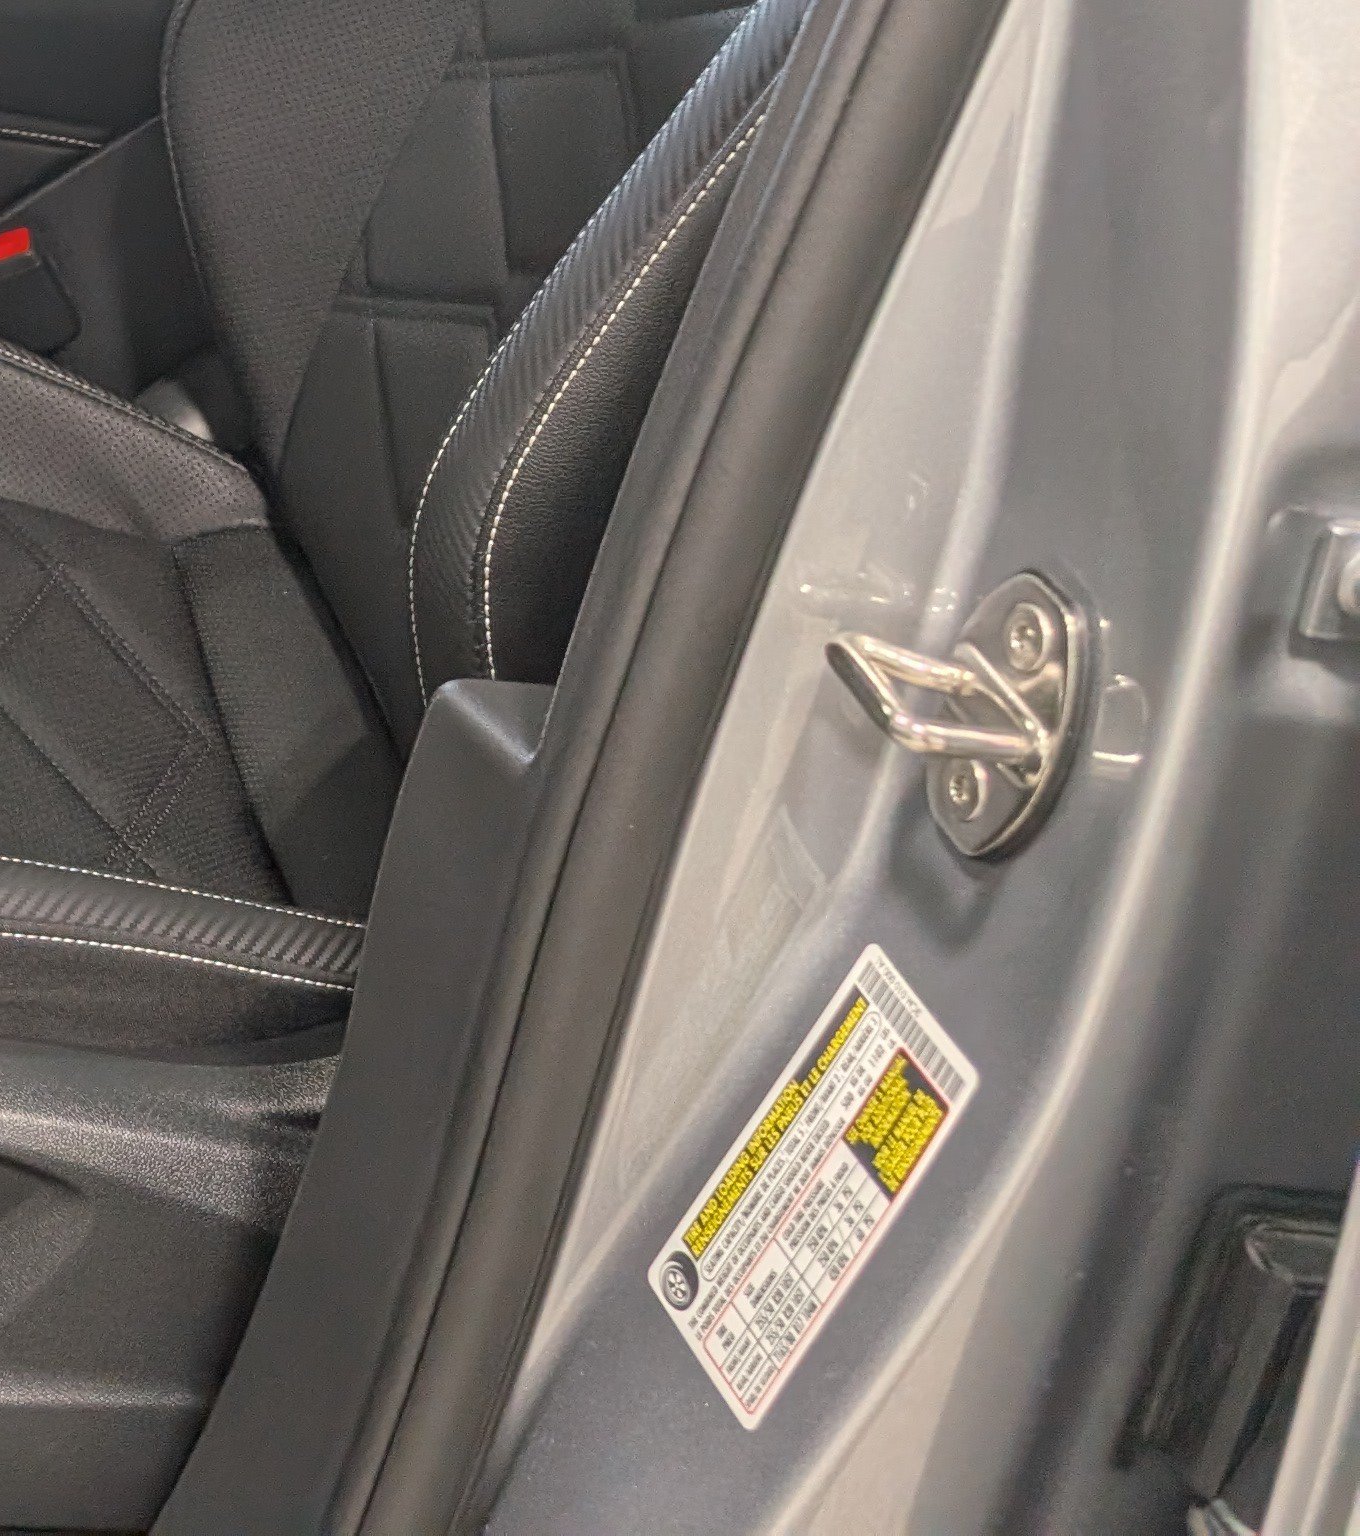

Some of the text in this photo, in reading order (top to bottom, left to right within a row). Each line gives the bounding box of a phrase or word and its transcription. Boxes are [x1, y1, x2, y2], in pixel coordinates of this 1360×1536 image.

[683, 1077, 799, 1247] TIRE AND LOADING INFORMATION
[691, 995, 868, 1258] RENSEIGNEMENTS SUR LES PNEUS ET LE CHARGEMENT
